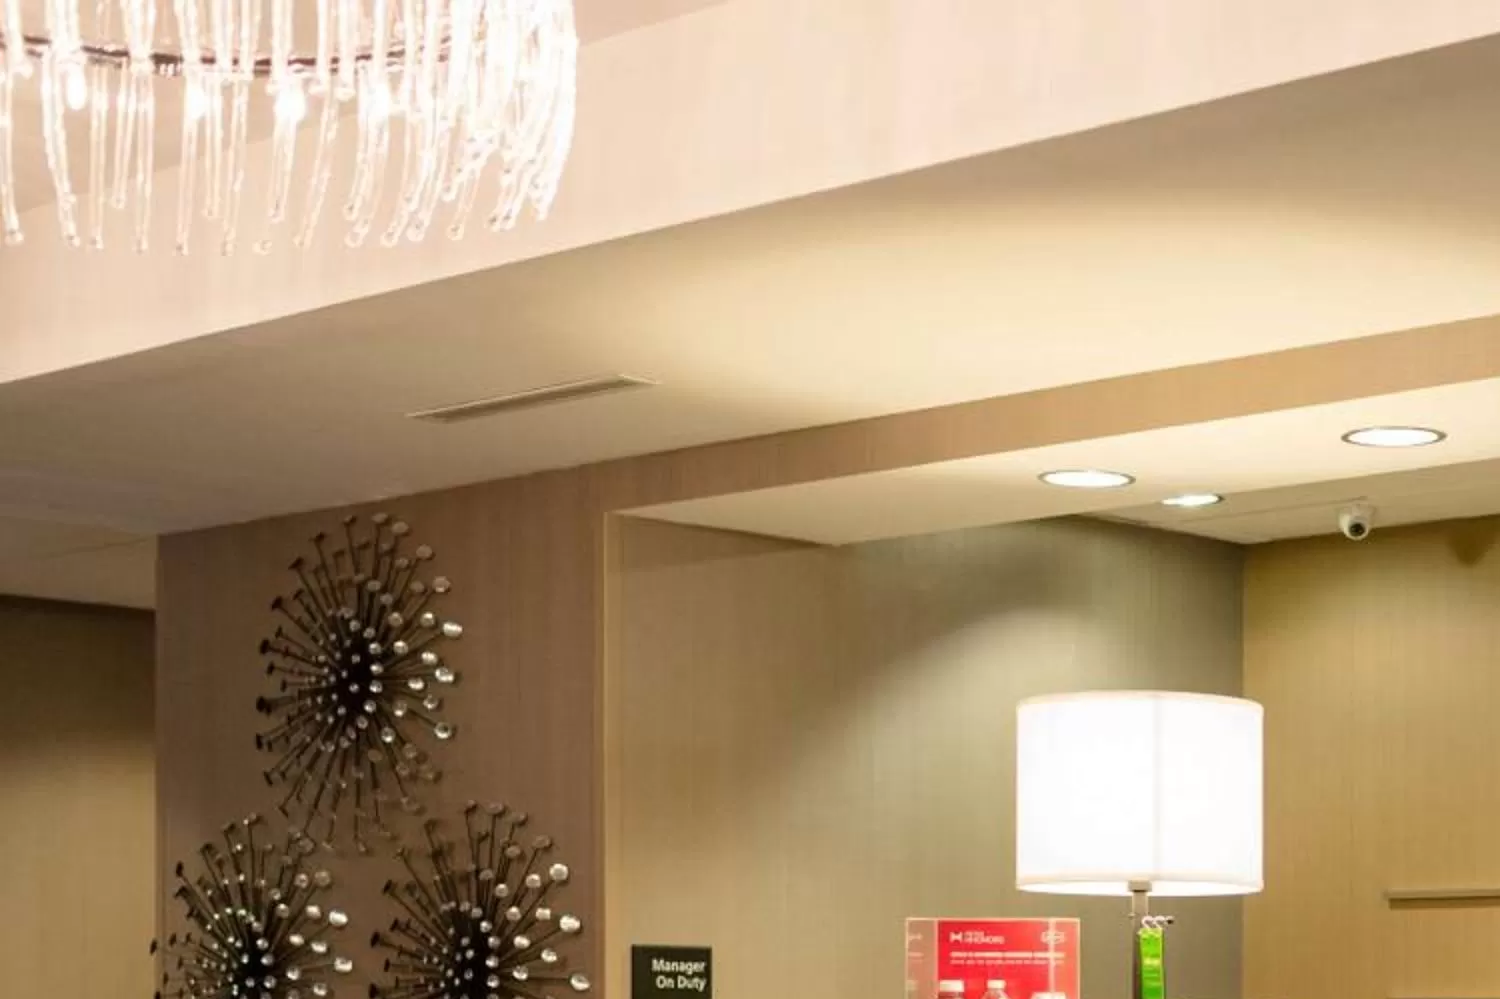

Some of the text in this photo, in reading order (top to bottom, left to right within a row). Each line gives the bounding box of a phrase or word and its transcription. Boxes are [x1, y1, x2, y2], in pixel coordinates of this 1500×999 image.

[651, 958, 706, 975] Manager
[655, 975, 706, 992] On Duty
